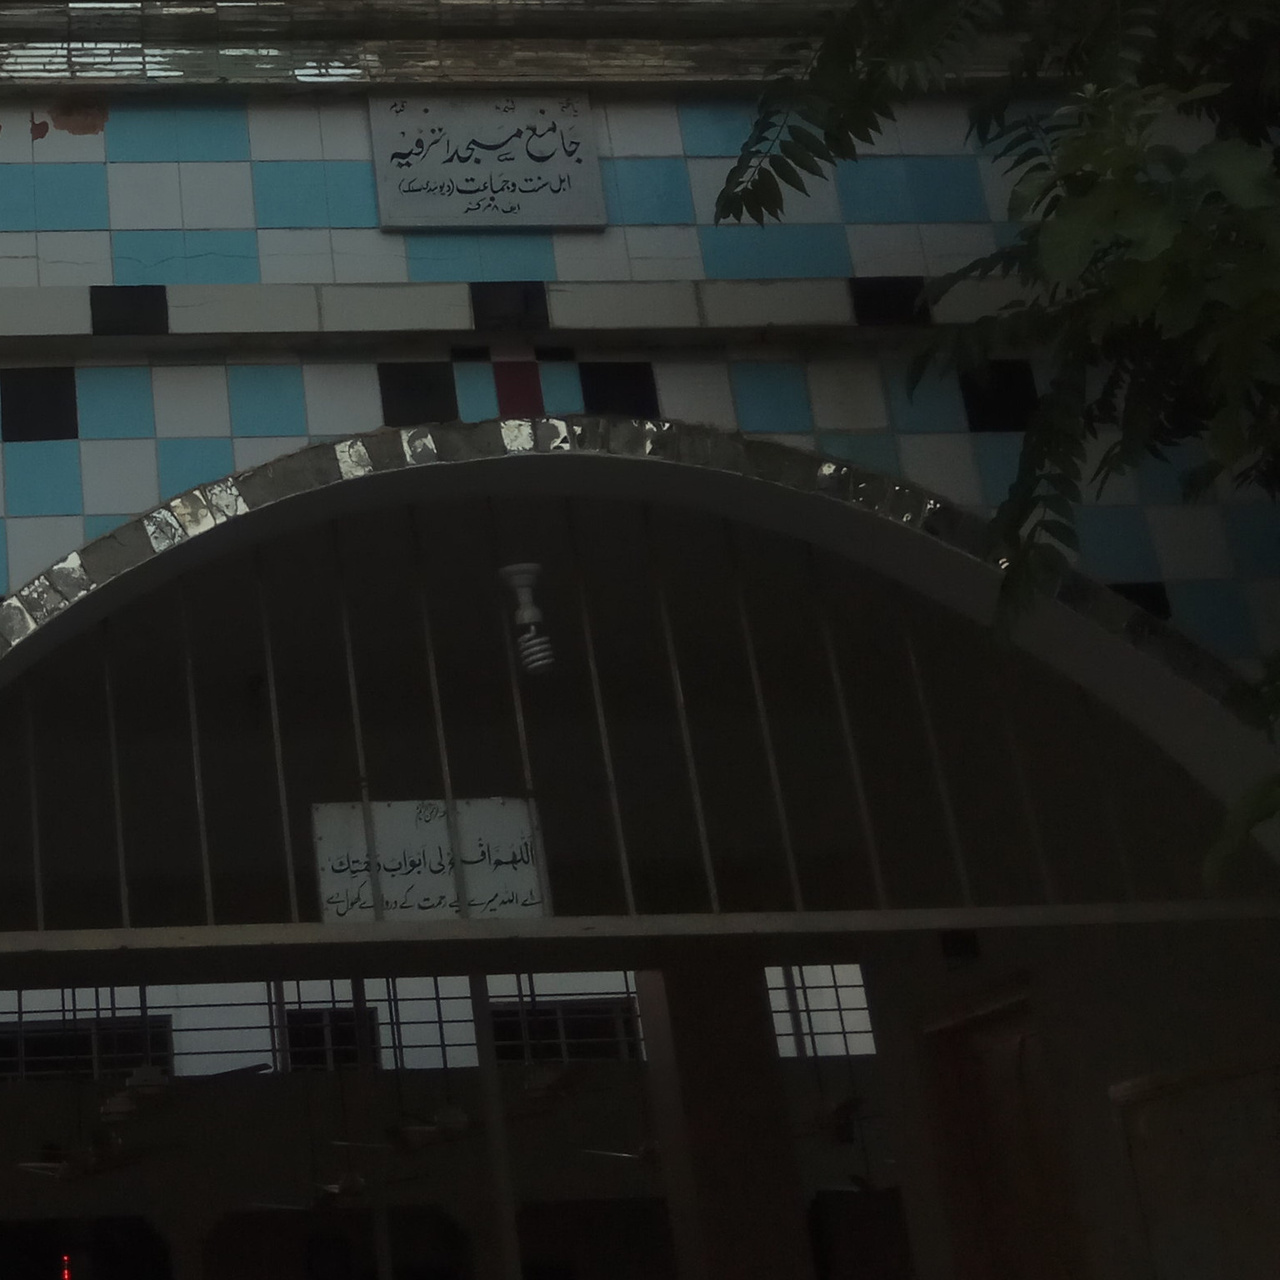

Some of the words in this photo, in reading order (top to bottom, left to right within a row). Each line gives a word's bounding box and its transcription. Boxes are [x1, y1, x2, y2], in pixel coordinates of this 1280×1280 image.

[441, 127, 525, 166] مسجد
[526, 120, 583, 165] جامع
[518, 176, 549, 194] سنت
